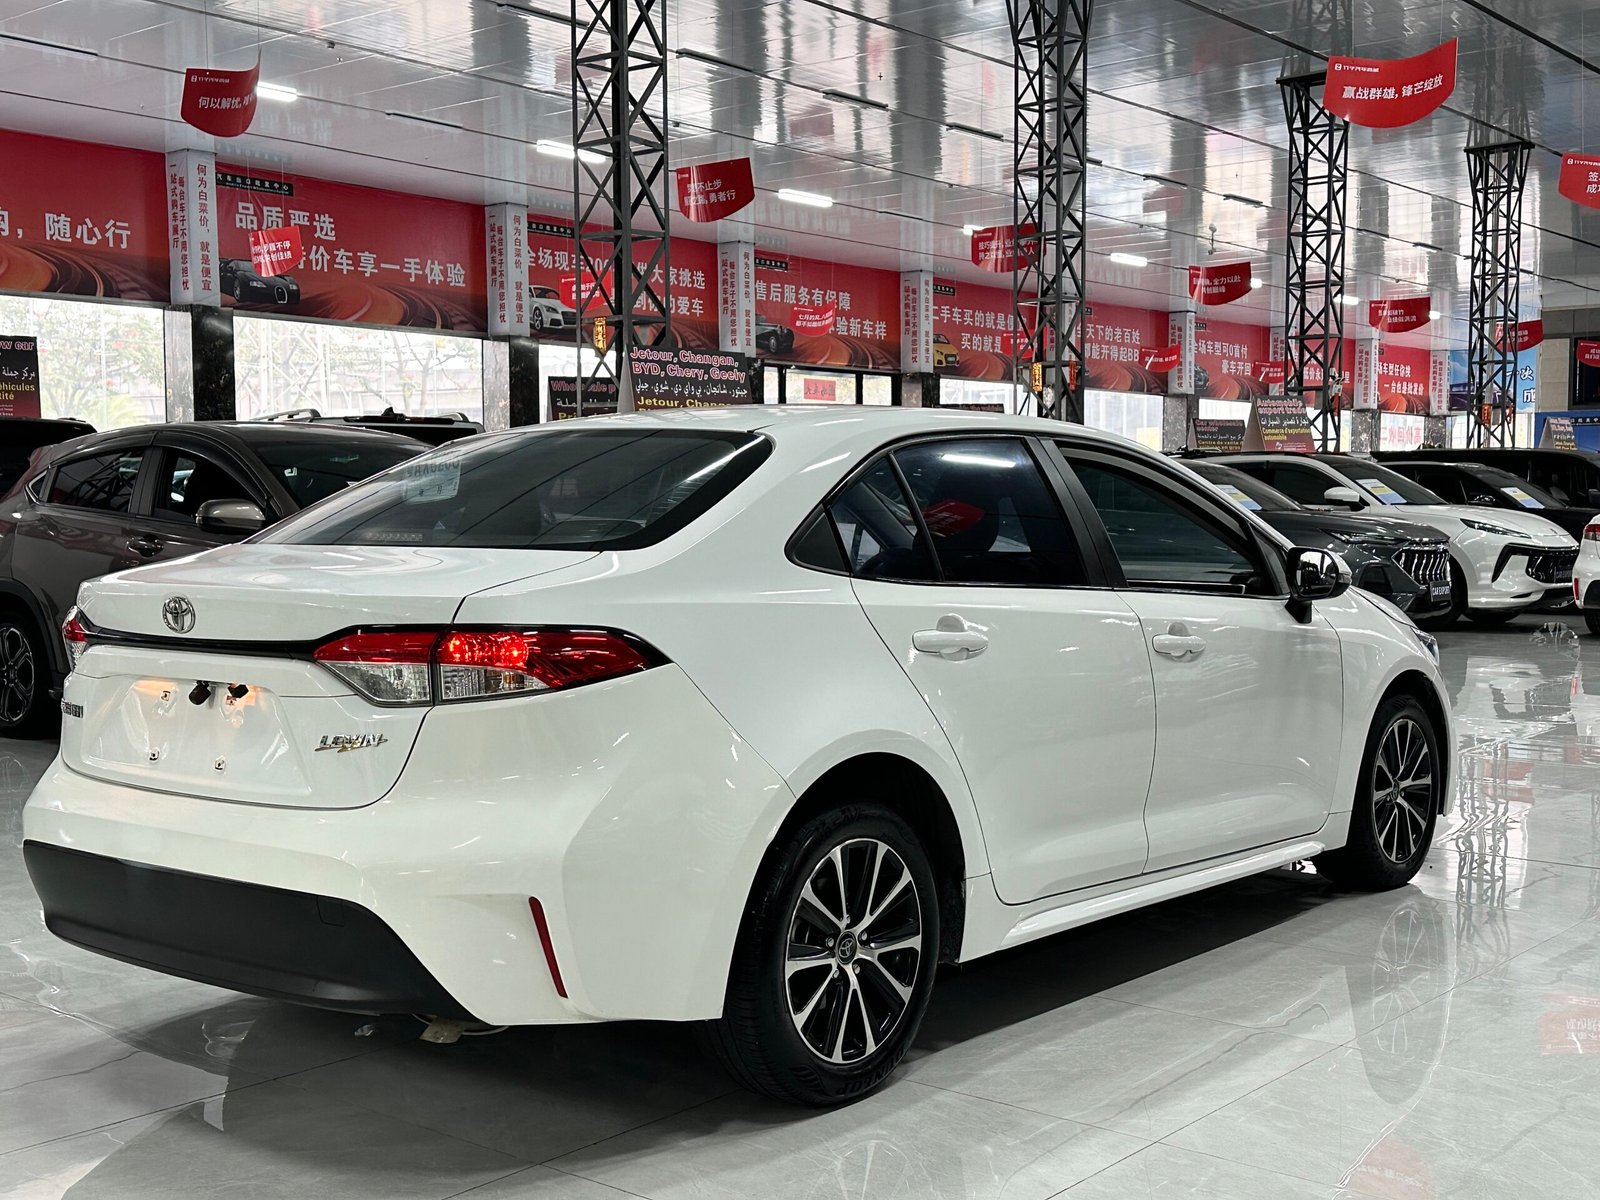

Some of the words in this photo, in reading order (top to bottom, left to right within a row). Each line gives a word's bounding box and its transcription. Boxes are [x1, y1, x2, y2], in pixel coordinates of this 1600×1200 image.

[236, 202, 336, 241] 品质严选
[755, 280, 850, 312] 售后服务有保障
[15, 341, 35, 351] car
[630, 347, 678, 363] Jetour,
[679, 350, 739, 367] Changan,
[632, 362, 665, 377] BYD,
[666, 365, 708, 381] Chery,
[709, 368, 745, 384] Geely
[638, 397, 684, 408] Jetour,
